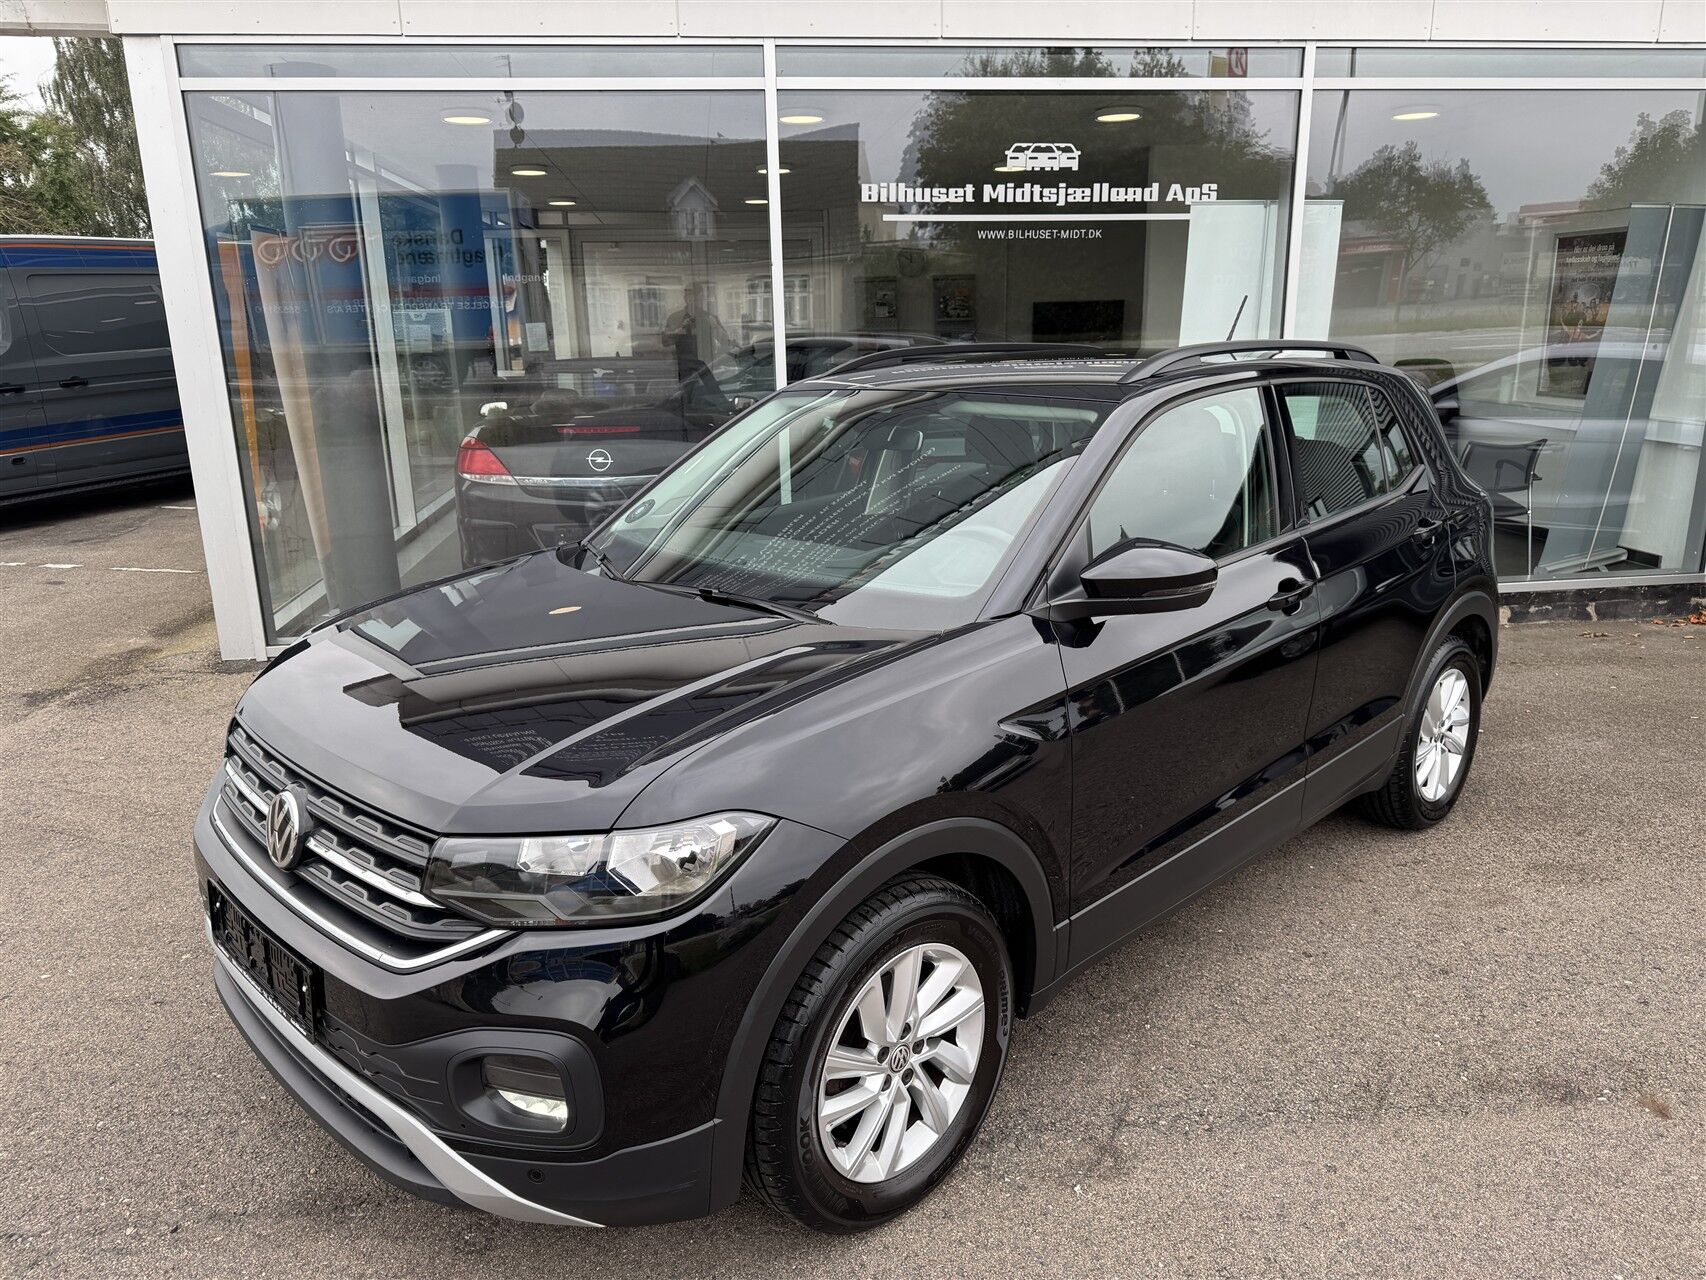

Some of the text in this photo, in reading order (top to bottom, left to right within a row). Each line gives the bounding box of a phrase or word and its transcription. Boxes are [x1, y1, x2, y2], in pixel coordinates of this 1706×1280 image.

[861, 183, 1217, 206] Bilhuset Midtsjælland ApS
[977, 229, 1102, 240] WWW.BILHUSET-MIDT.DK
